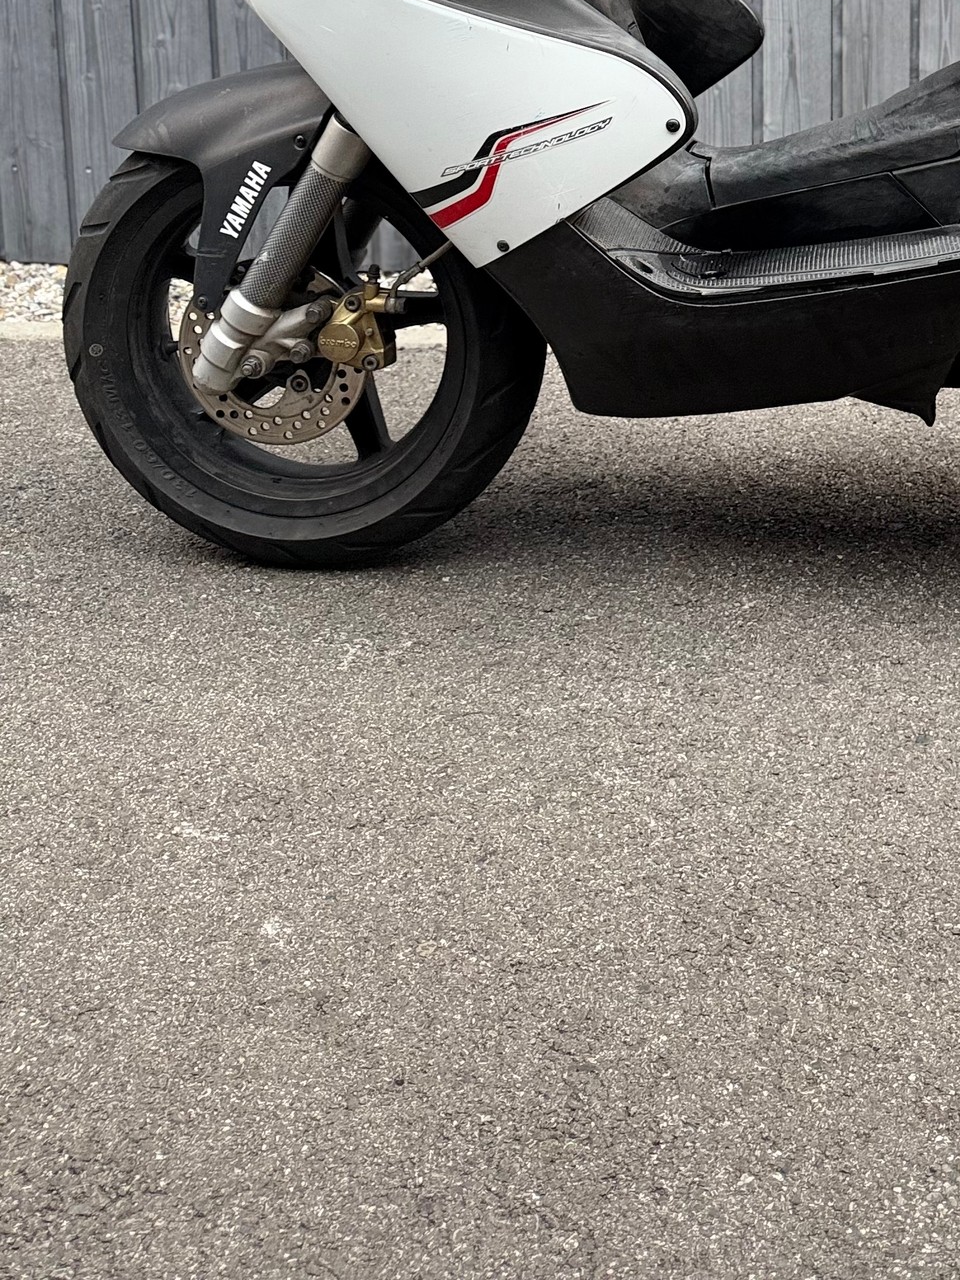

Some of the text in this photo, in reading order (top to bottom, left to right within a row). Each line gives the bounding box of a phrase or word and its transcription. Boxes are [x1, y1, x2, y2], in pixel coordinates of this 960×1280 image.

[442, 117, 613, 176] SPORT TECHNOLOGY
[219, 160, 273, 239] YAMAHA
[320, 335, 357, 348] brembo
